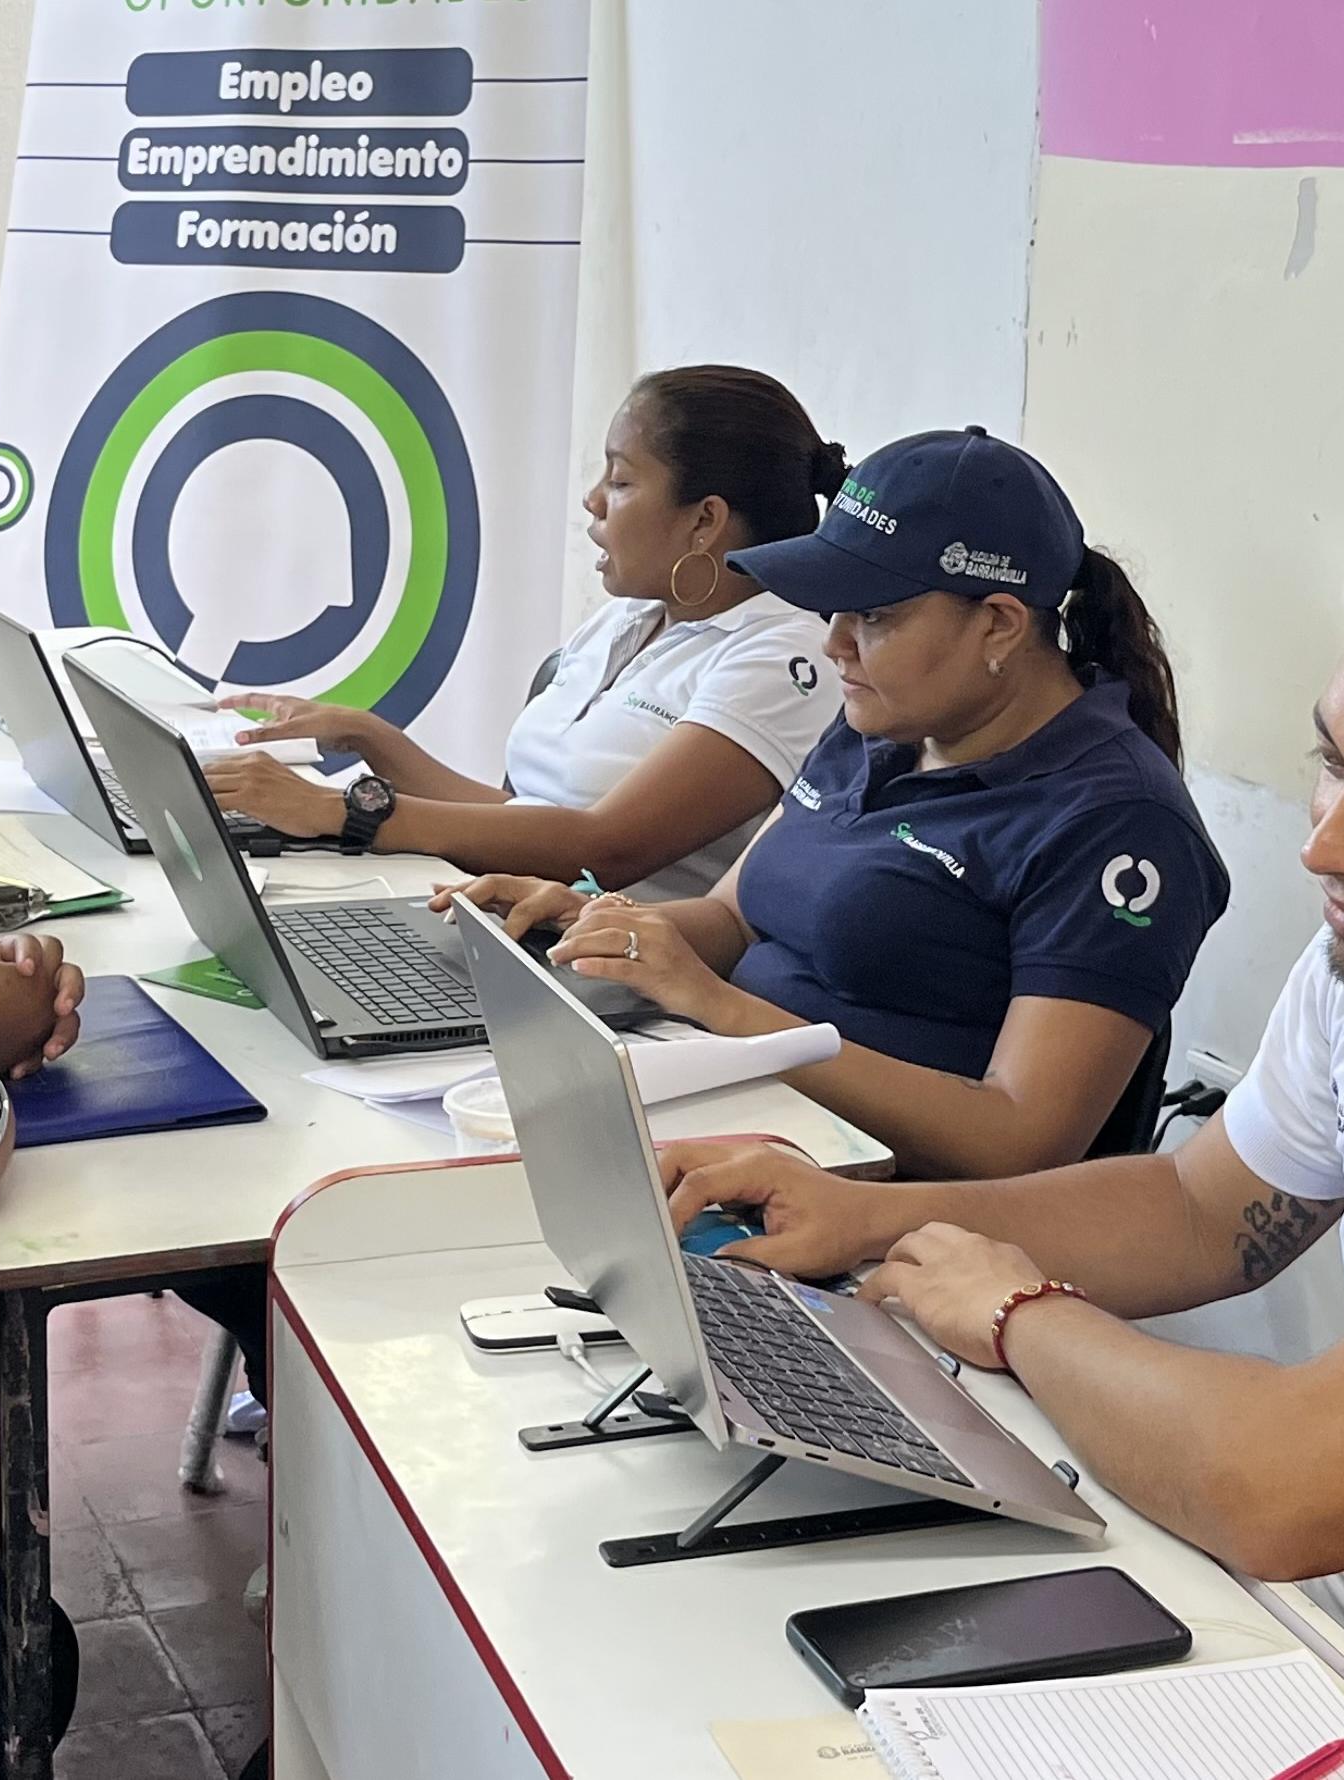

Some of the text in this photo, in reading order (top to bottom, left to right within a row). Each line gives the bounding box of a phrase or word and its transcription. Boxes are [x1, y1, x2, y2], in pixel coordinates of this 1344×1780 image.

[219, 60, 373, 113] Empleo
[127, 135, 463, 186] Emprendimiento
[177, 210, 397, 254] Formación
